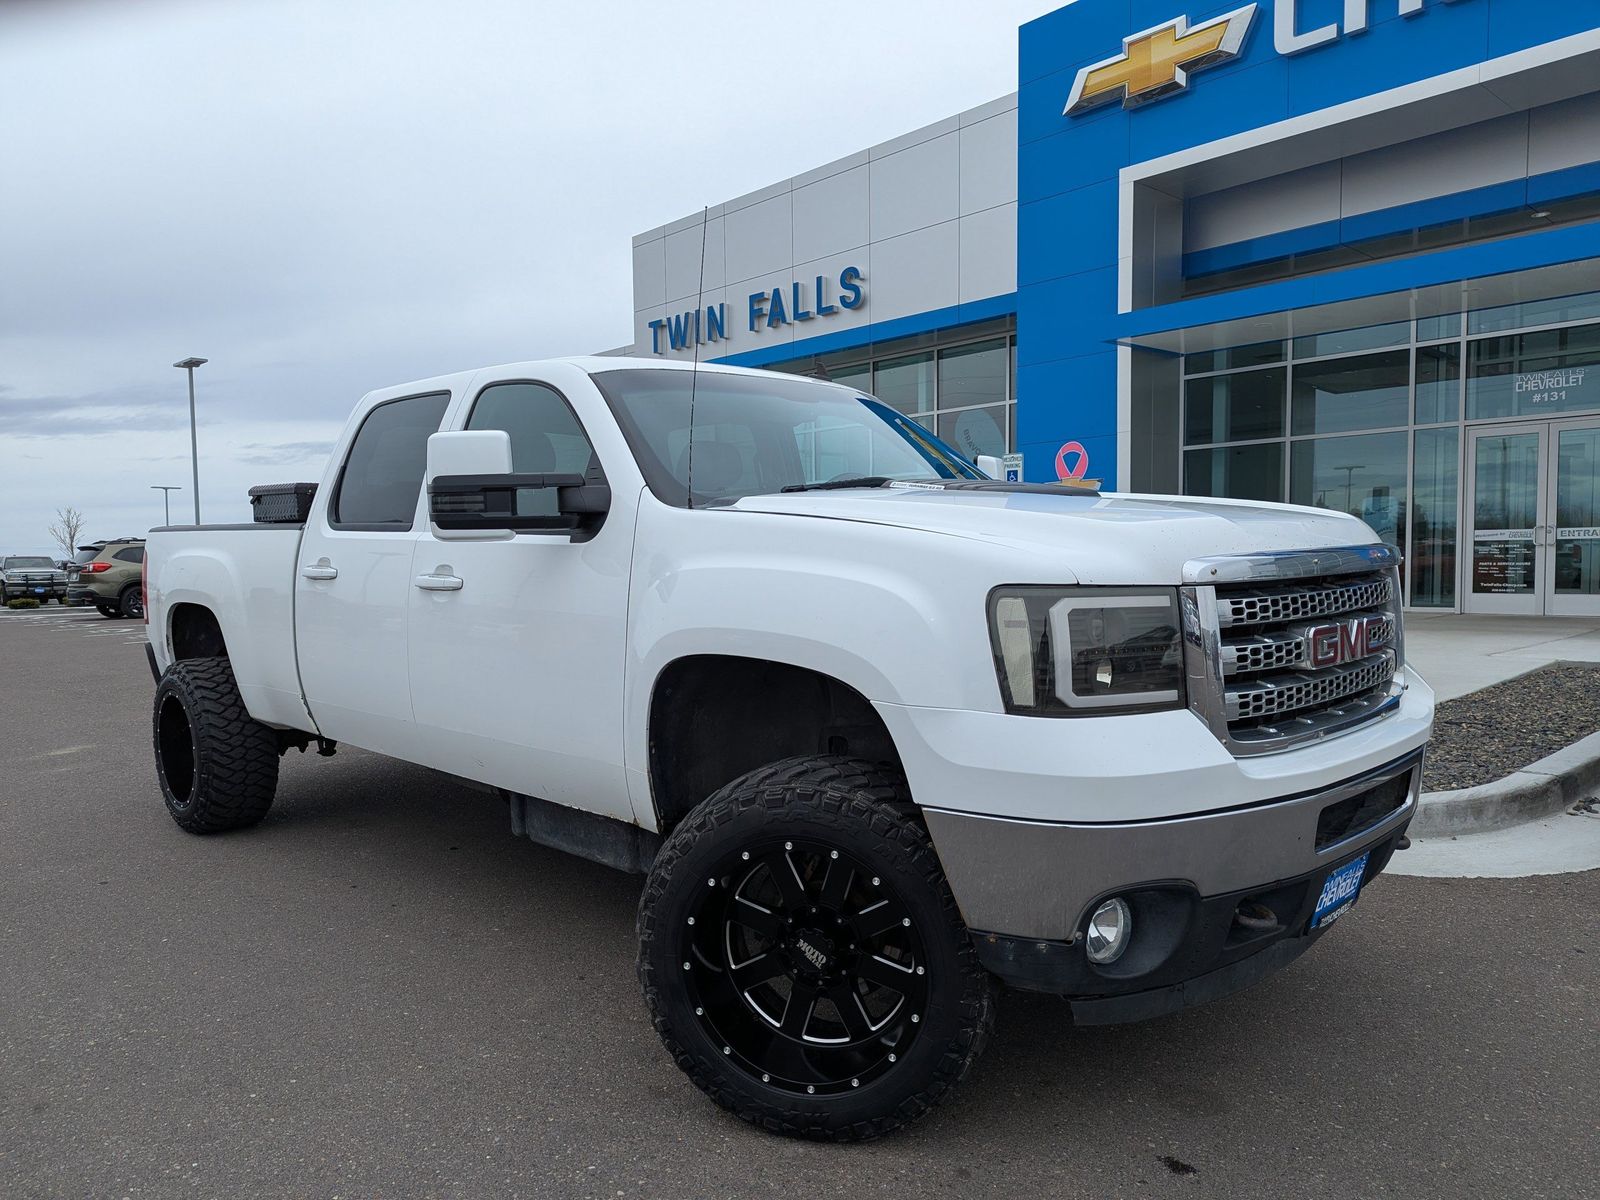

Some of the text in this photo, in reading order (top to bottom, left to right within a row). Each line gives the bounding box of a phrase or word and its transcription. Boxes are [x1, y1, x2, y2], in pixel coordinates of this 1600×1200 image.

[648, 266, 865, 354] TWIN FALLS
[1516, 375, 1584, 392] CHEVROLET
[1532, 390, 1566, 403] #131
[963, 429, 985, 455] BRAVO
[1560, 529, 1600, 537] ENTRA
[1309, 616, 1385, 672] GMC
[796, 939, 826, 963] MOTO
